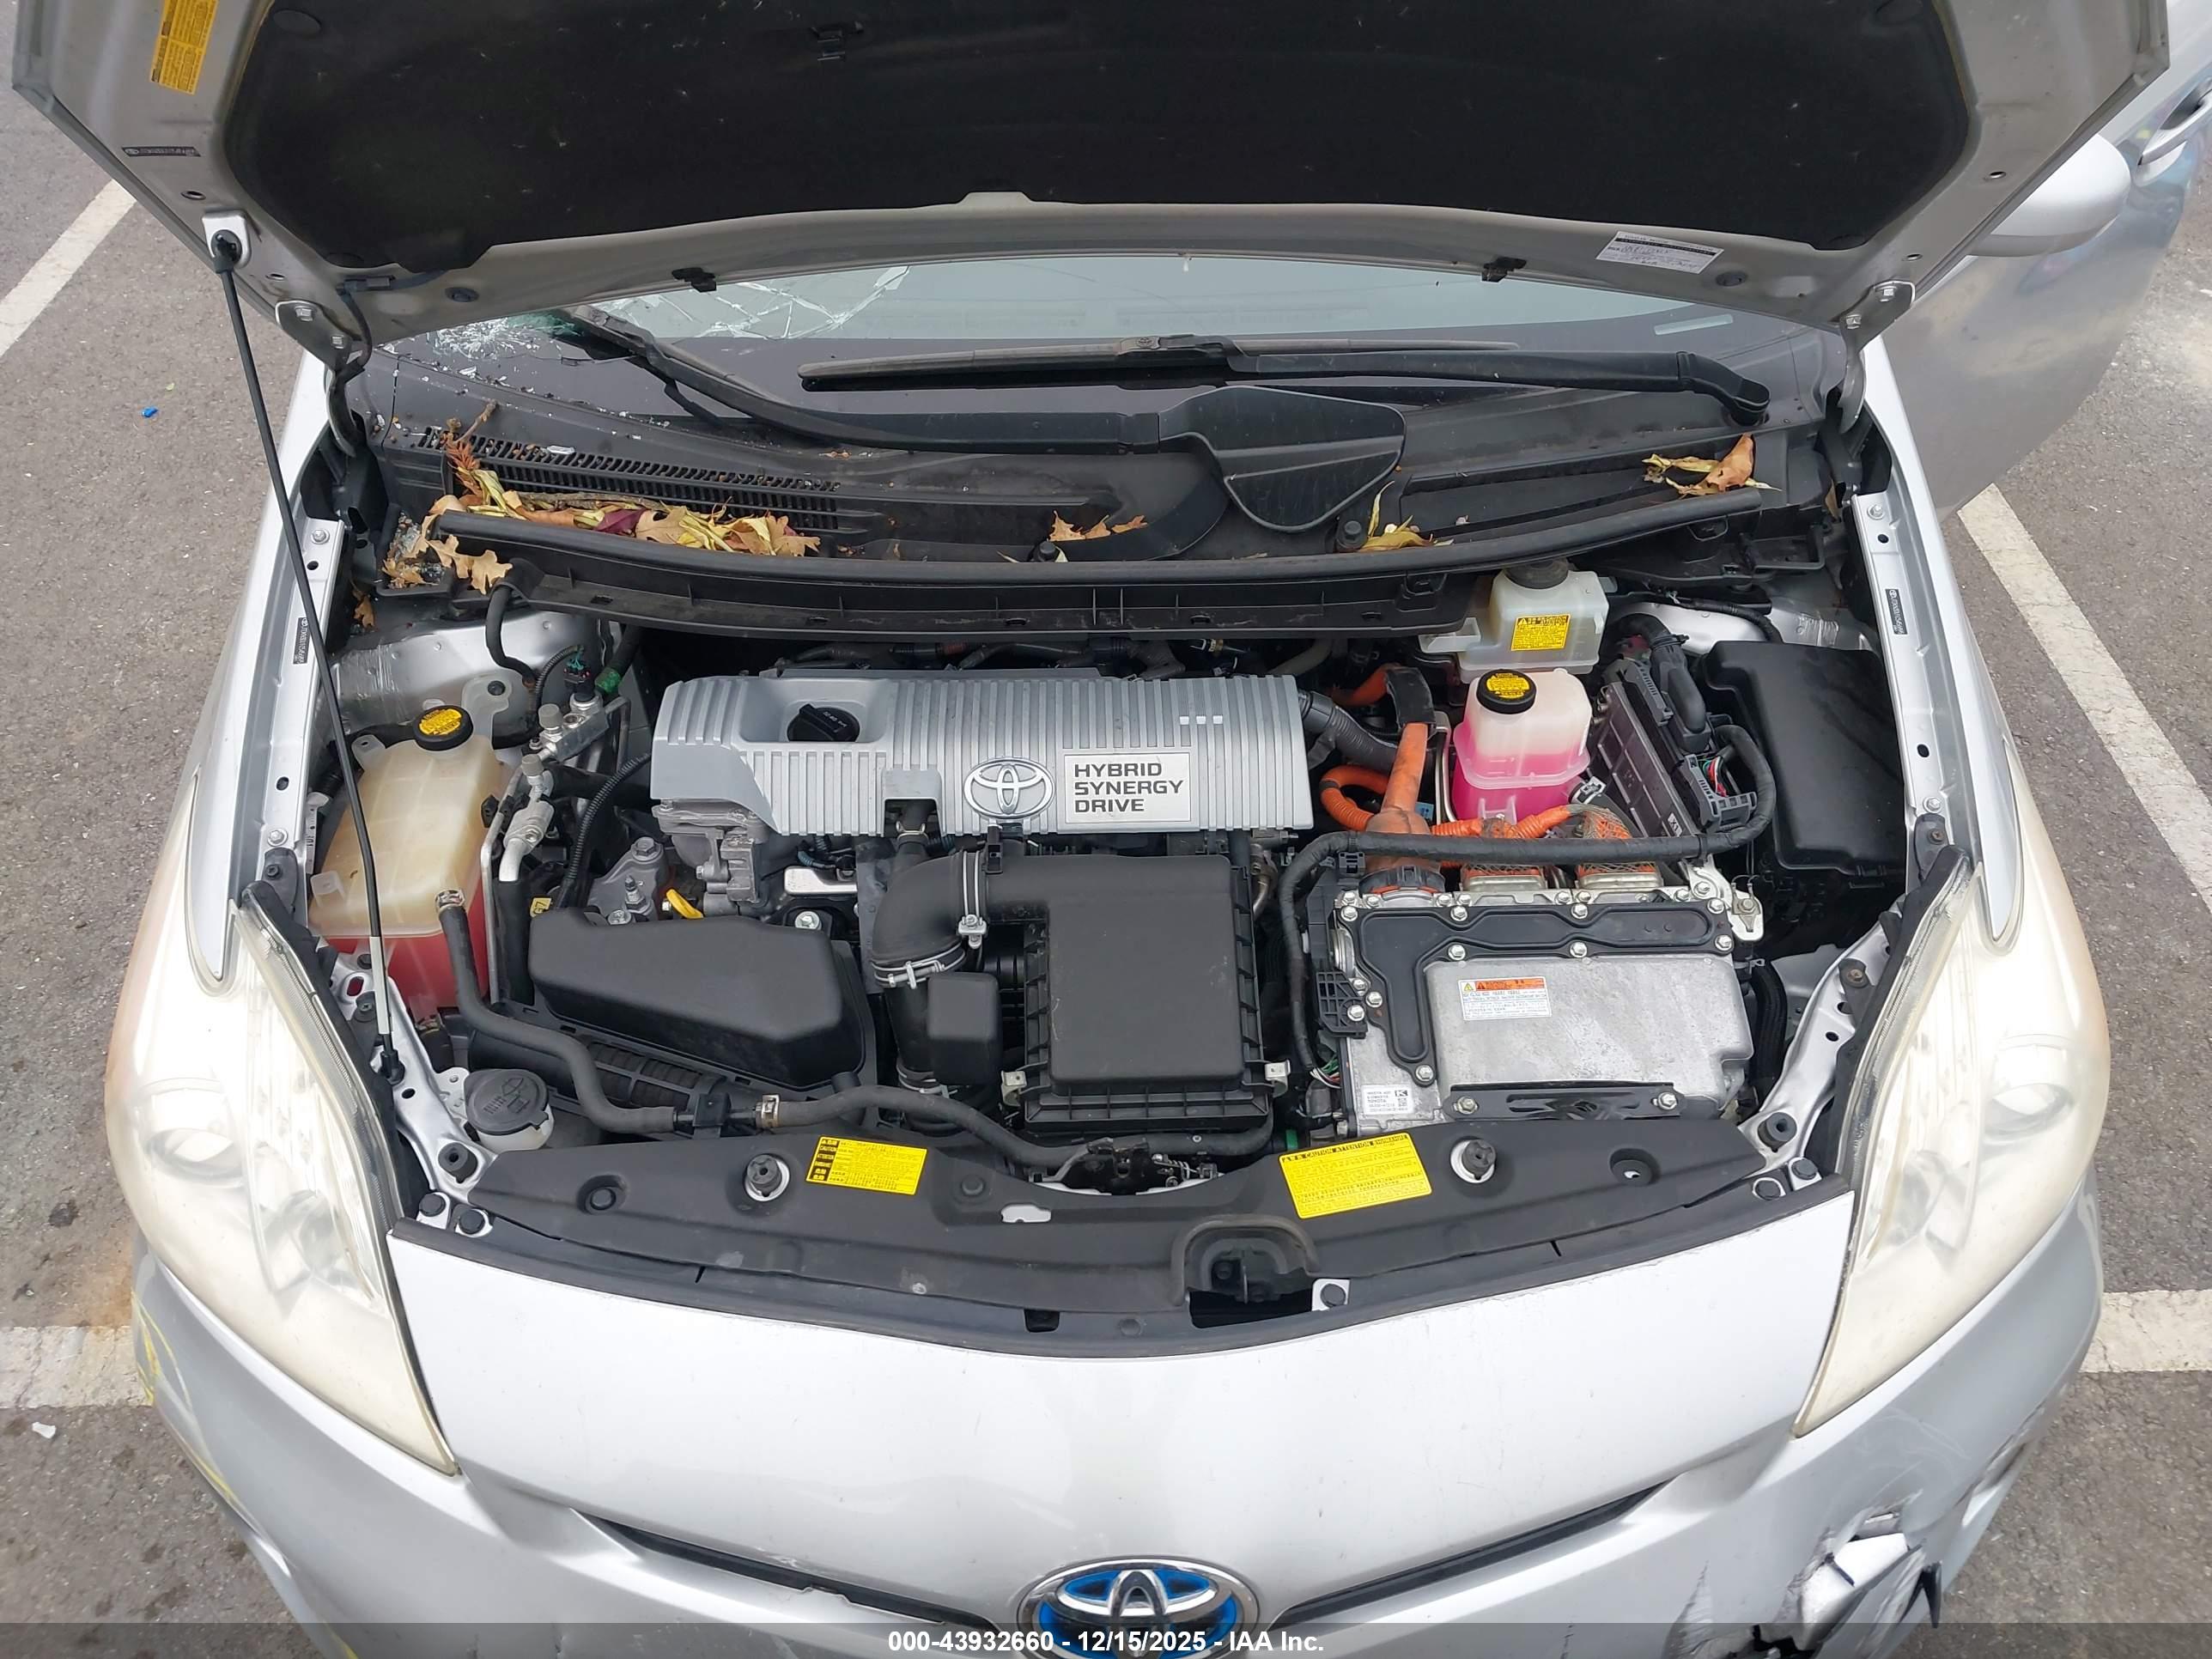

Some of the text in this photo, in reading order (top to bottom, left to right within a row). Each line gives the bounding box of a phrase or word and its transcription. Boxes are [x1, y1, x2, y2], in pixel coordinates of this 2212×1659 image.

[1074, 763, 1162, 778] HYBRID
[1074, 780, 1183, 795] SYNERGY
[1074, 799, 1145, 813] DRIVE
